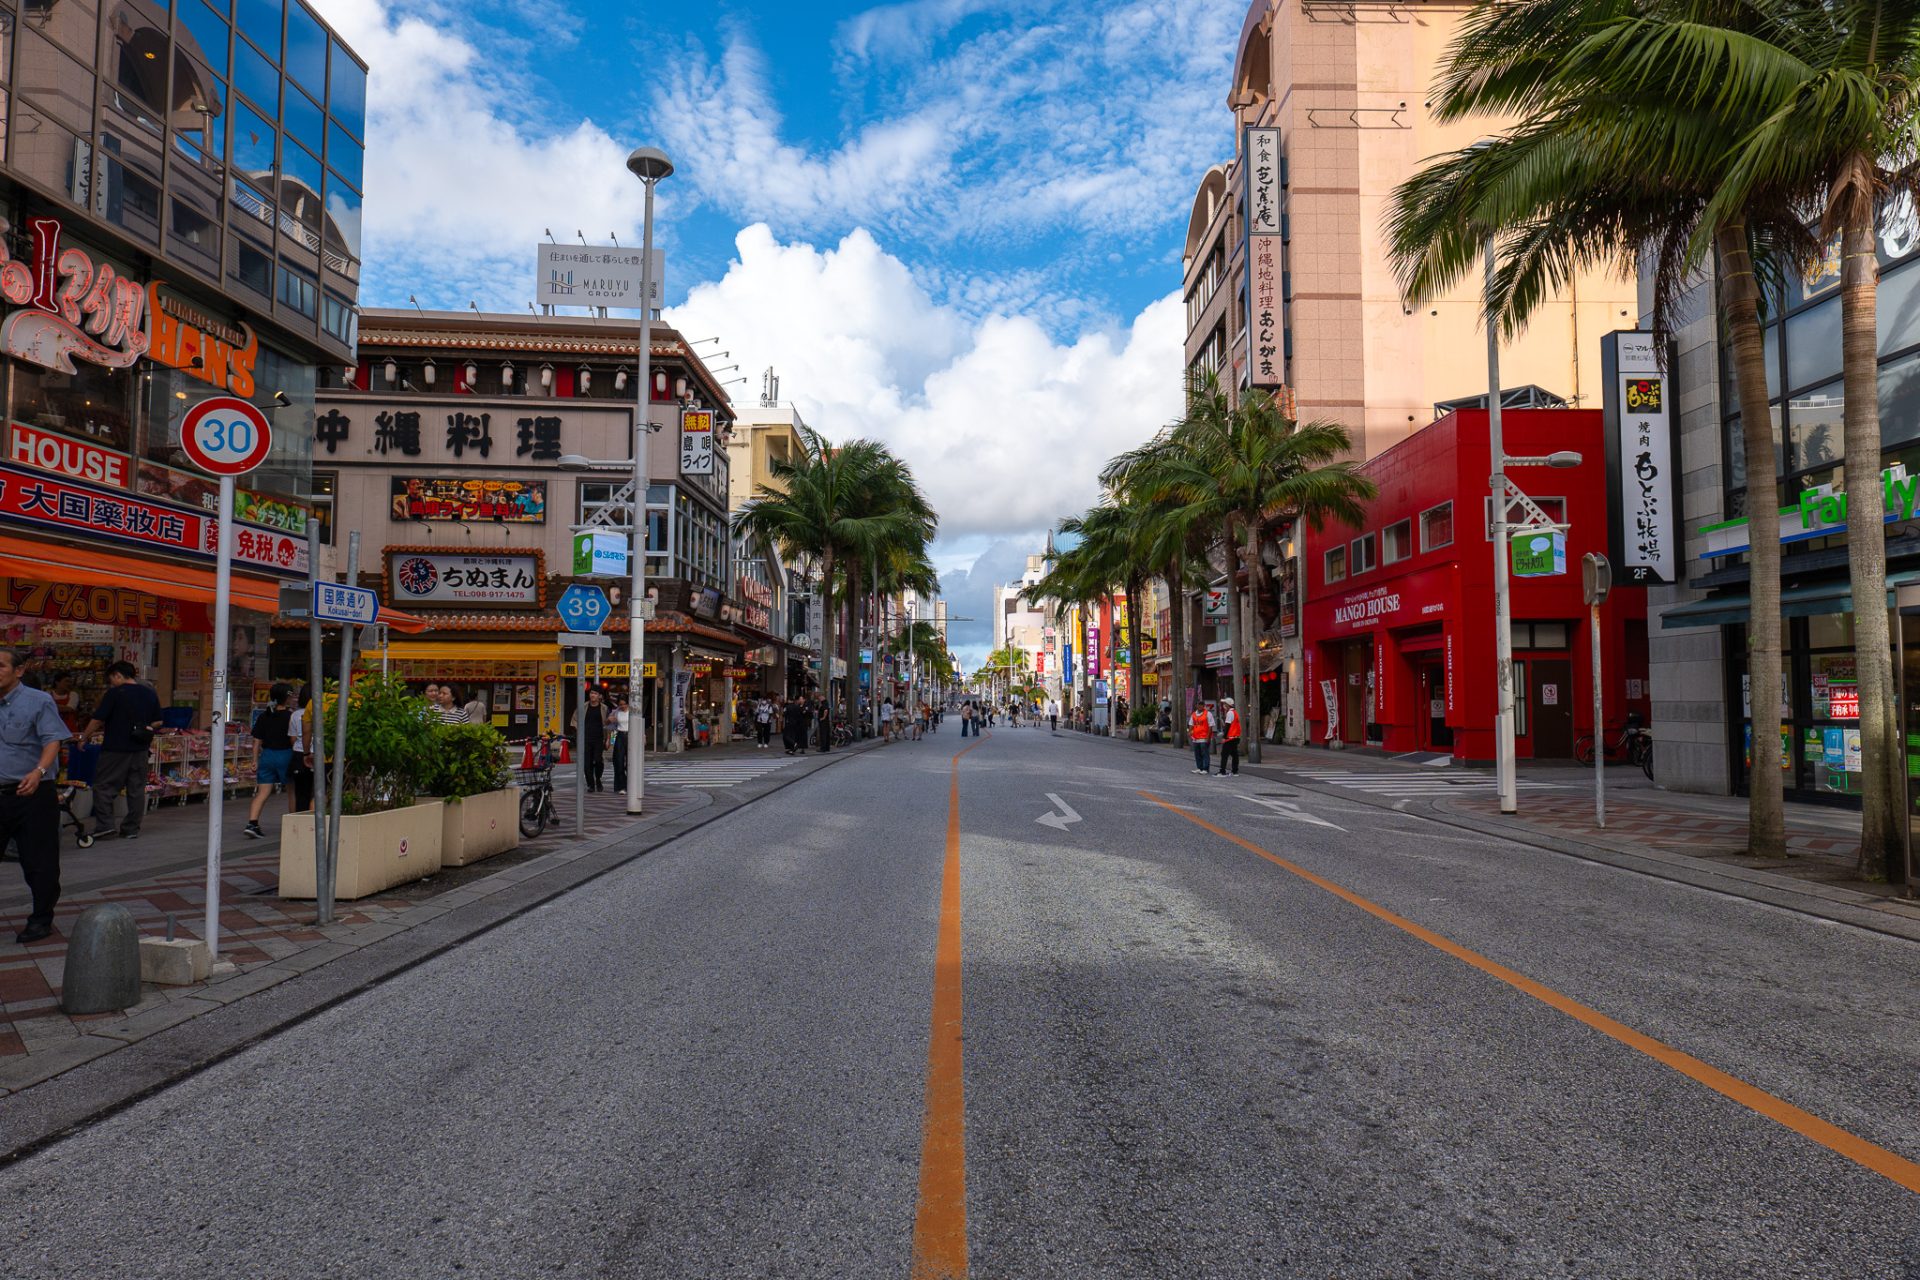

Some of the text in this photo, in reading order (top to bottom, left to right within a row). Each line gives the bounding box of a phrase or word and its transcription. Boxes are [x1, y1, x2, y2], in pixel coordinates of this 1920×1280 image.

[1256, 134, 1272, 163] 和食
[584, 279, 629, 291] MARUYU
[1258, 237, 1276, 376] 沖縄地料理 あんがま
[684, 414, 710, 430] 無料
[203, 418, 251, 453] 30
[683, 435, 711, 452] 島唄
[1638, 421, 1651, 447] 焼肉
[12, 429, 122, 487] HOUSE
[682, 453, 711, 469] ライブ
[1634, 451, 1661, 561] もとぶ牧場
[1800, 468, 1918, 529] Faly
[237, 529, 274, 563] 免税
[442, 566, 534, 589] ちぬまん
[1633, 569, 1647, 580] 2F
[324, 588, 366, 609] 国際通り
[568, 598, 600, 617] 39
[1335, 593, 1400, 624] MANGO HOUSE
[327, 606, 363, 618] Kokusai-dori
[120, 646, 138, 661] Tax
